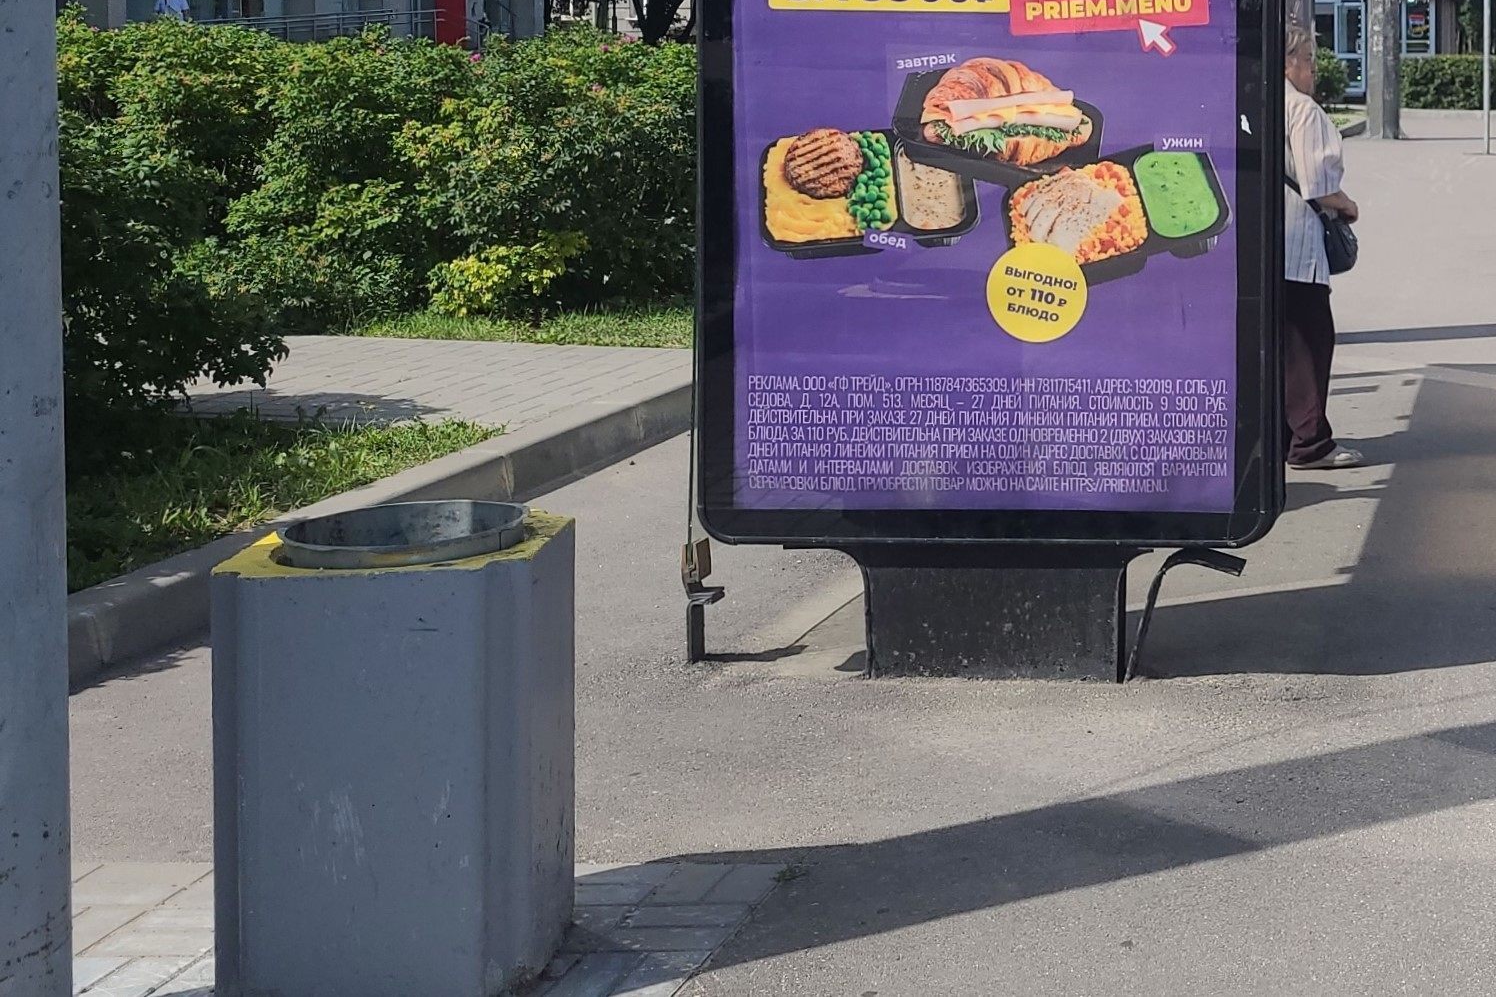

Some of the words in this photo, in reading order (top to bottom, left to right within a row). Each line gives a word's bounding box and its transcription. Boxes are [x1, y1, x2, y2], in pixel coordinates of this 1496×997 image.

[896, 53, 956, 69] завтрак
[1162, 137, 1203, 150] ужин
[869, 232, 906, 249] обед
[1004, 265, 1078, 290] ВЫГОДНО!
[1030, 288, 1056, 305] 110
[1006, 302, 1060, 323] БЛЮДО
[803, 376, 826, 391] ООО
[850, 374, 893, 393] ТРЕЙД»,
[895, 376, 923, 392] ОГРН
[1011, 377, 1035, 393] ИНН
[1095, 378, 1133, 394] АДРЕС:
[1134, 379, 1174, 395] 192019,
[1176, 379, 1183, 394] Г.
[1185, 379, 1209, 395] СПБ,
[1211, 379, 1228, 396] УЛ.
[748, 392, 793, 409] СЕДОВА,
[847, 393, 875, 408] ПОМ.
[882, 394, 904, 408] 513.
[910, 394, 952, 410] МЕСЯЦ
[971, 394, 984, 409] 27
[991, 393, 1022, 410] ДНЕЙ
[1029, 394, 1082, 410] ПИТАНИЯ.
[1088, 395, 1153, 410] СТОИМОСТЬ
[1160, 396, 1168, 411] 9
[1175, 396, 1198, 411] 900
[1205, 396, 1228, 413] РУБ.
[747, 408, 838, 425] ДЕЙСТВИТЕЛЬНА
[841, 410, 864, 425] ПРИ
[867, 410, 906, 425] ЗАКАЗЕ
[909, 411, 922, 425] 27
[924, 409, 956, 426] ДНЕЙ
[959, 411, 1009, 426] ПИТАНИЯ
[1012, 410, 1064, 426] ЛИНЕЙКИ
[1067, 411, 1117, 427] ПИТАНИЯ
[1163, 413, 1228, 428] СТОИМОСТЬ
[748, 425, 789, 442] БЛЮДА
[790, 426, 805, 440] ЗА
[807, 427, 824, 441] 110
[826, 427, 849, 443] РУБ.
[850, 425, 940, 443] ДЕЙСТВИТЕЛЬНА
[943, 427, 966, 442] ПРИ
[967, 427, 1007, 442] ЗАКАЗЕ
[1009, 428, 1098, 443] ОДНОВРЕМЕННО
[1100, 429, 1108, 443] 2
[1110, 429, 1145, 445] (ДВУХ)
[1147, 429, 1195, 444] ЗАКАЗОВ
[1197, 430, 1213, 444] НА
[1214, 430, 1227, 444] 27
[747, 442, 778, 458] ДНЕЙ
[780, 443, 831, 457] ПИТАНИЯ
[833, 442, 885, 458] ЛИНЕЙКИ
[887, 443, 939, 458] ПИТАНИЯ
[941, 444, 978, 459] ПРИЕМ
[981, 445, 996, 459] НА
[998, 445, 1031, 460] ОДИН
[1033, 445, 1068, 460] АДРЕС
[1131, 446, 1139, 460] С
[1140, 446, 1228, 462] ОДИНАКОВЫМИ
[747, 459, 792, 474] ДАТАМИ
[799, 460, 808, 474] И
[814, 460, 894, 475] ИНТЕРВАЛАМИ
[966, 461, 1046, 475] ИЗОБРАЖЕНИЯ
[1053, 461, 1088, 477] БЛЮД
[1093, 462, 1155, 477] ЯВЛЯЮТСЯ
[1162, 462, 1228, 477] ВАРИАНТОМ
[749, 475, 819, 491] СЕРВИРОВКИ
[858, 476, 928, 492] ПРИОБРЕСТИ
[929, 477, 965, 491] ТОВАР
[966, 477, 1009, 492] МОЖНО
[1009, 477, 1025, 492] НА
[1026, 475, 1060, 492] САЙТЕ
